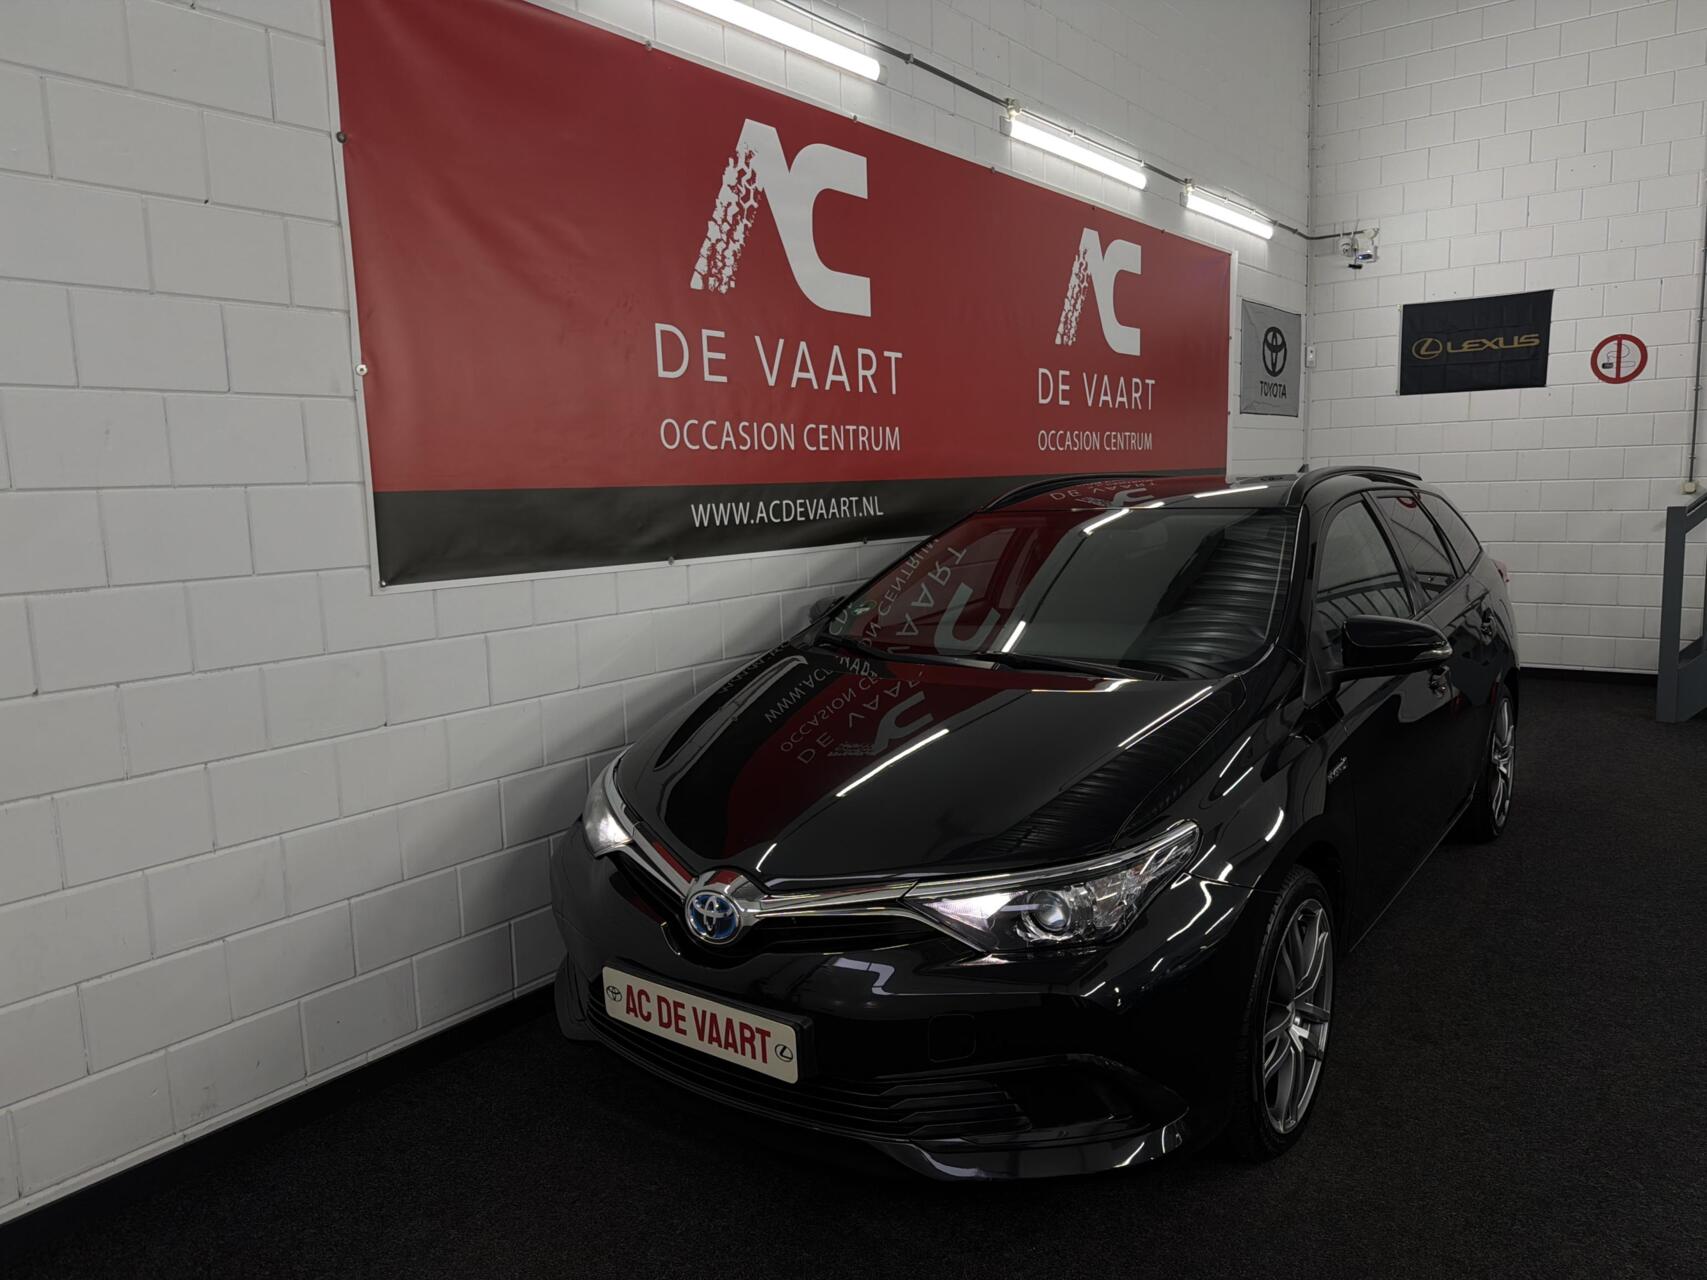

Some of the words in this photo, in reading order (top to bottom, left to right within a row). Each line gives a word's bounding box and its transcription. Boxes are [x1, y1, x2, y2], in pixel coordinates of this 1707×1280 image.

[690, 118, 871, 317] AC
[1055, 227, 1142, 356] AC
[654, 323, 728, 383] DE
[754, 336, 903, 394] VAART
[1447, 334, 1540, 353] LEXUS
[1038, 367, 1070, 406] DE
[1082, 372, 1155, 411] VAART
[1260, 381, 1287, 399] TOYOTA
[660, 418, 796, 450] OCCASION
[803, 424, 901, 452] CENTRUM
[1038, 430, 1100, 451] OCCASION
[1103, 431, 1153, 451] CENTRUM
[691, 496, 884, 528] WWW.ACDEVAART.NL
[625, 984, 651, 1022] AC
[656, 995, 687, 1036] DE
[692, 1006, 771, 1064] VAART
